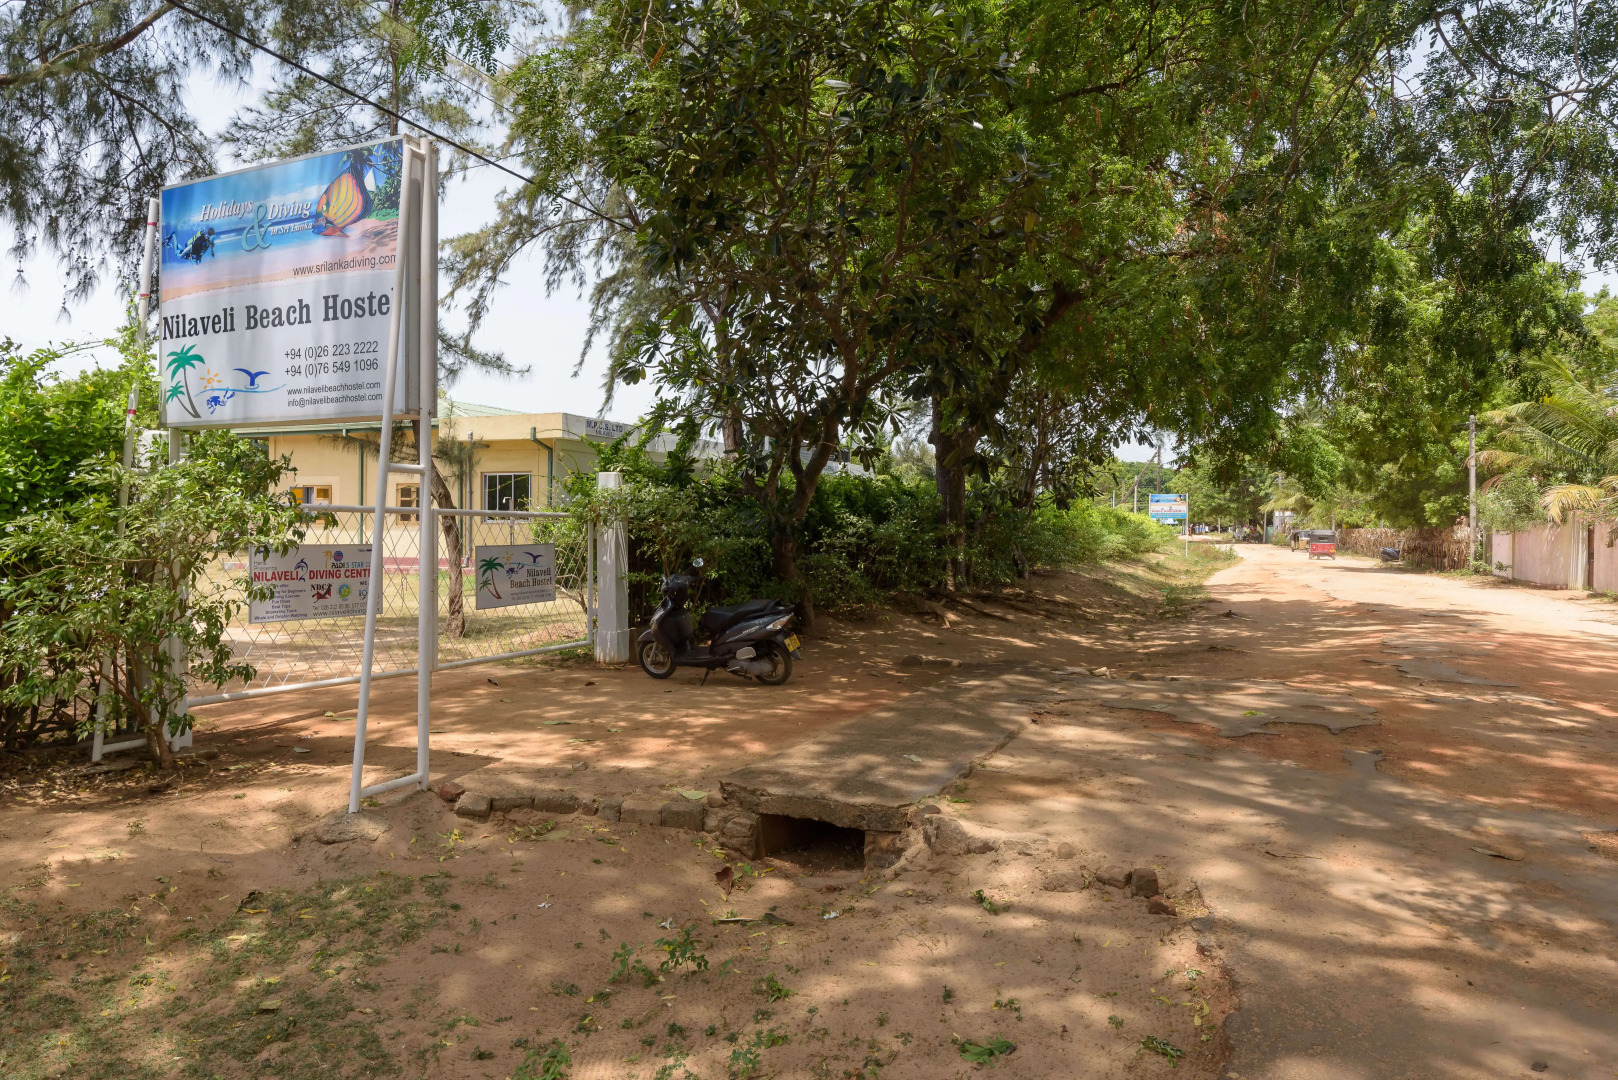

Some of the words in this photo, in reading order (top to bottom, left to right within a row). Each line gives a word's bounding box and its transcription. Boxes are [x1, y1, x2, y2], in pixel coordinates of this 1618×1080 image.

[200, 199, 253, 222] Holidays
[241, 202, 272, 251] &
[267, 201, 311, 221] Diving
[278, 224, 290, 235] Sri
[290, 221, 313, 232] Lanka
[162, 306, 235, 341] Nilaveli
[245, 298, 311, 330] Beach
[322, 287, 393, 322] Hoste
[285, 347, 301, 360] +94
[304, 345, 329, 360] (0)26
[332, 343, 350, 357] 223
[353, 340, 379, 355] 2222
[285, 364, 302, 377] +94
[304, 362, 329, 377] (0)76
[332, 360, 350, 374] 549
[354, 358, 379, 372] 1096
[287, 381, 381, 395] www.nilavelibeachhostel.com
[287, 392, 383, 407] info@nilavelibeachhostel.com
[254, 570, 299, 582] NILAVELI
[308, 569, 342, 580] DIVING
[510, 579, 531, 588] Beach
[532, 577, 552, 587] Hostel
